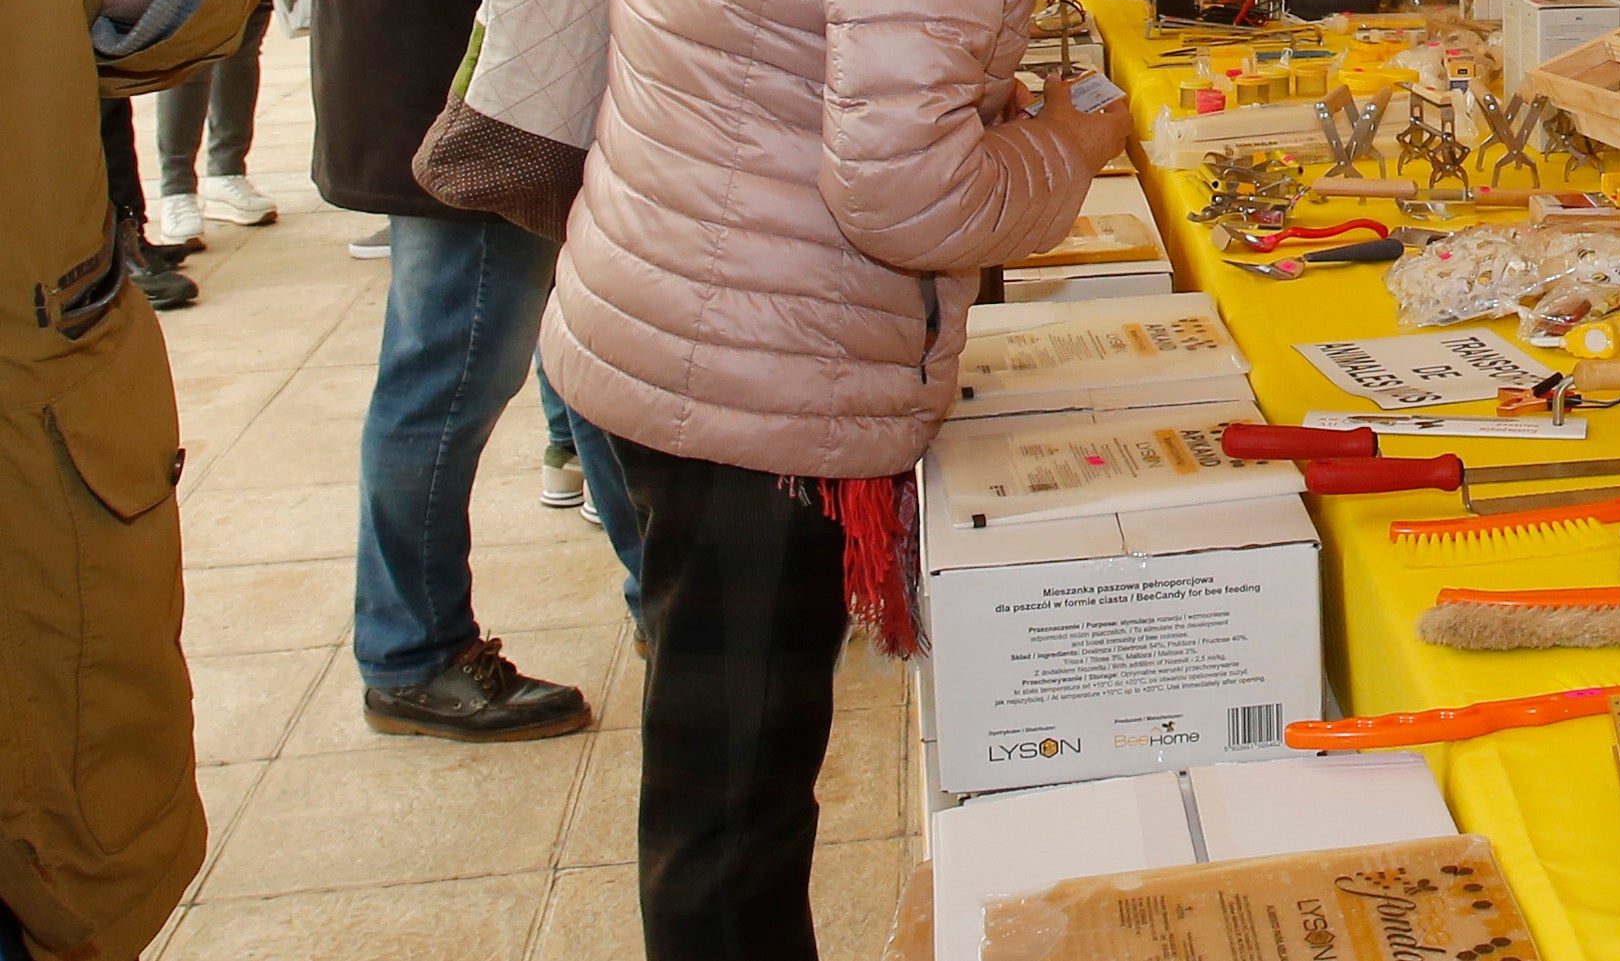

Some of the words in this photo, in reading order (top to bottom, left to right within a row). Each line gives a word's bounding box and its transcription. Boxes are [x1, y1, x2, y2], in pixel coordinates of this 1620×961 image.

[1315, 342, 1405, 390] ANIMALES
[1412, 364, 1463, 381] DE
[995, 603, 1011, 613] dla
[1065, 596, 1096, 607] formie
[1098, 595, 1128, 605] ciasta
[1136, 589, 1185, 602] BeeCandy
[1189, 588, 1202, 596] for
[1205, 587, 1222, 596] bee
[1225, 584, 1261, 594] feeding
[1043, 585, 1094, 596] Mieszanka
[1097, 581, 1139, 594] paszowa
[989, 737, 1081, 762] LYSON
[1114, 732, 1200, 748] BeeHome
[1297, 898, 1337, 961] LYSON
